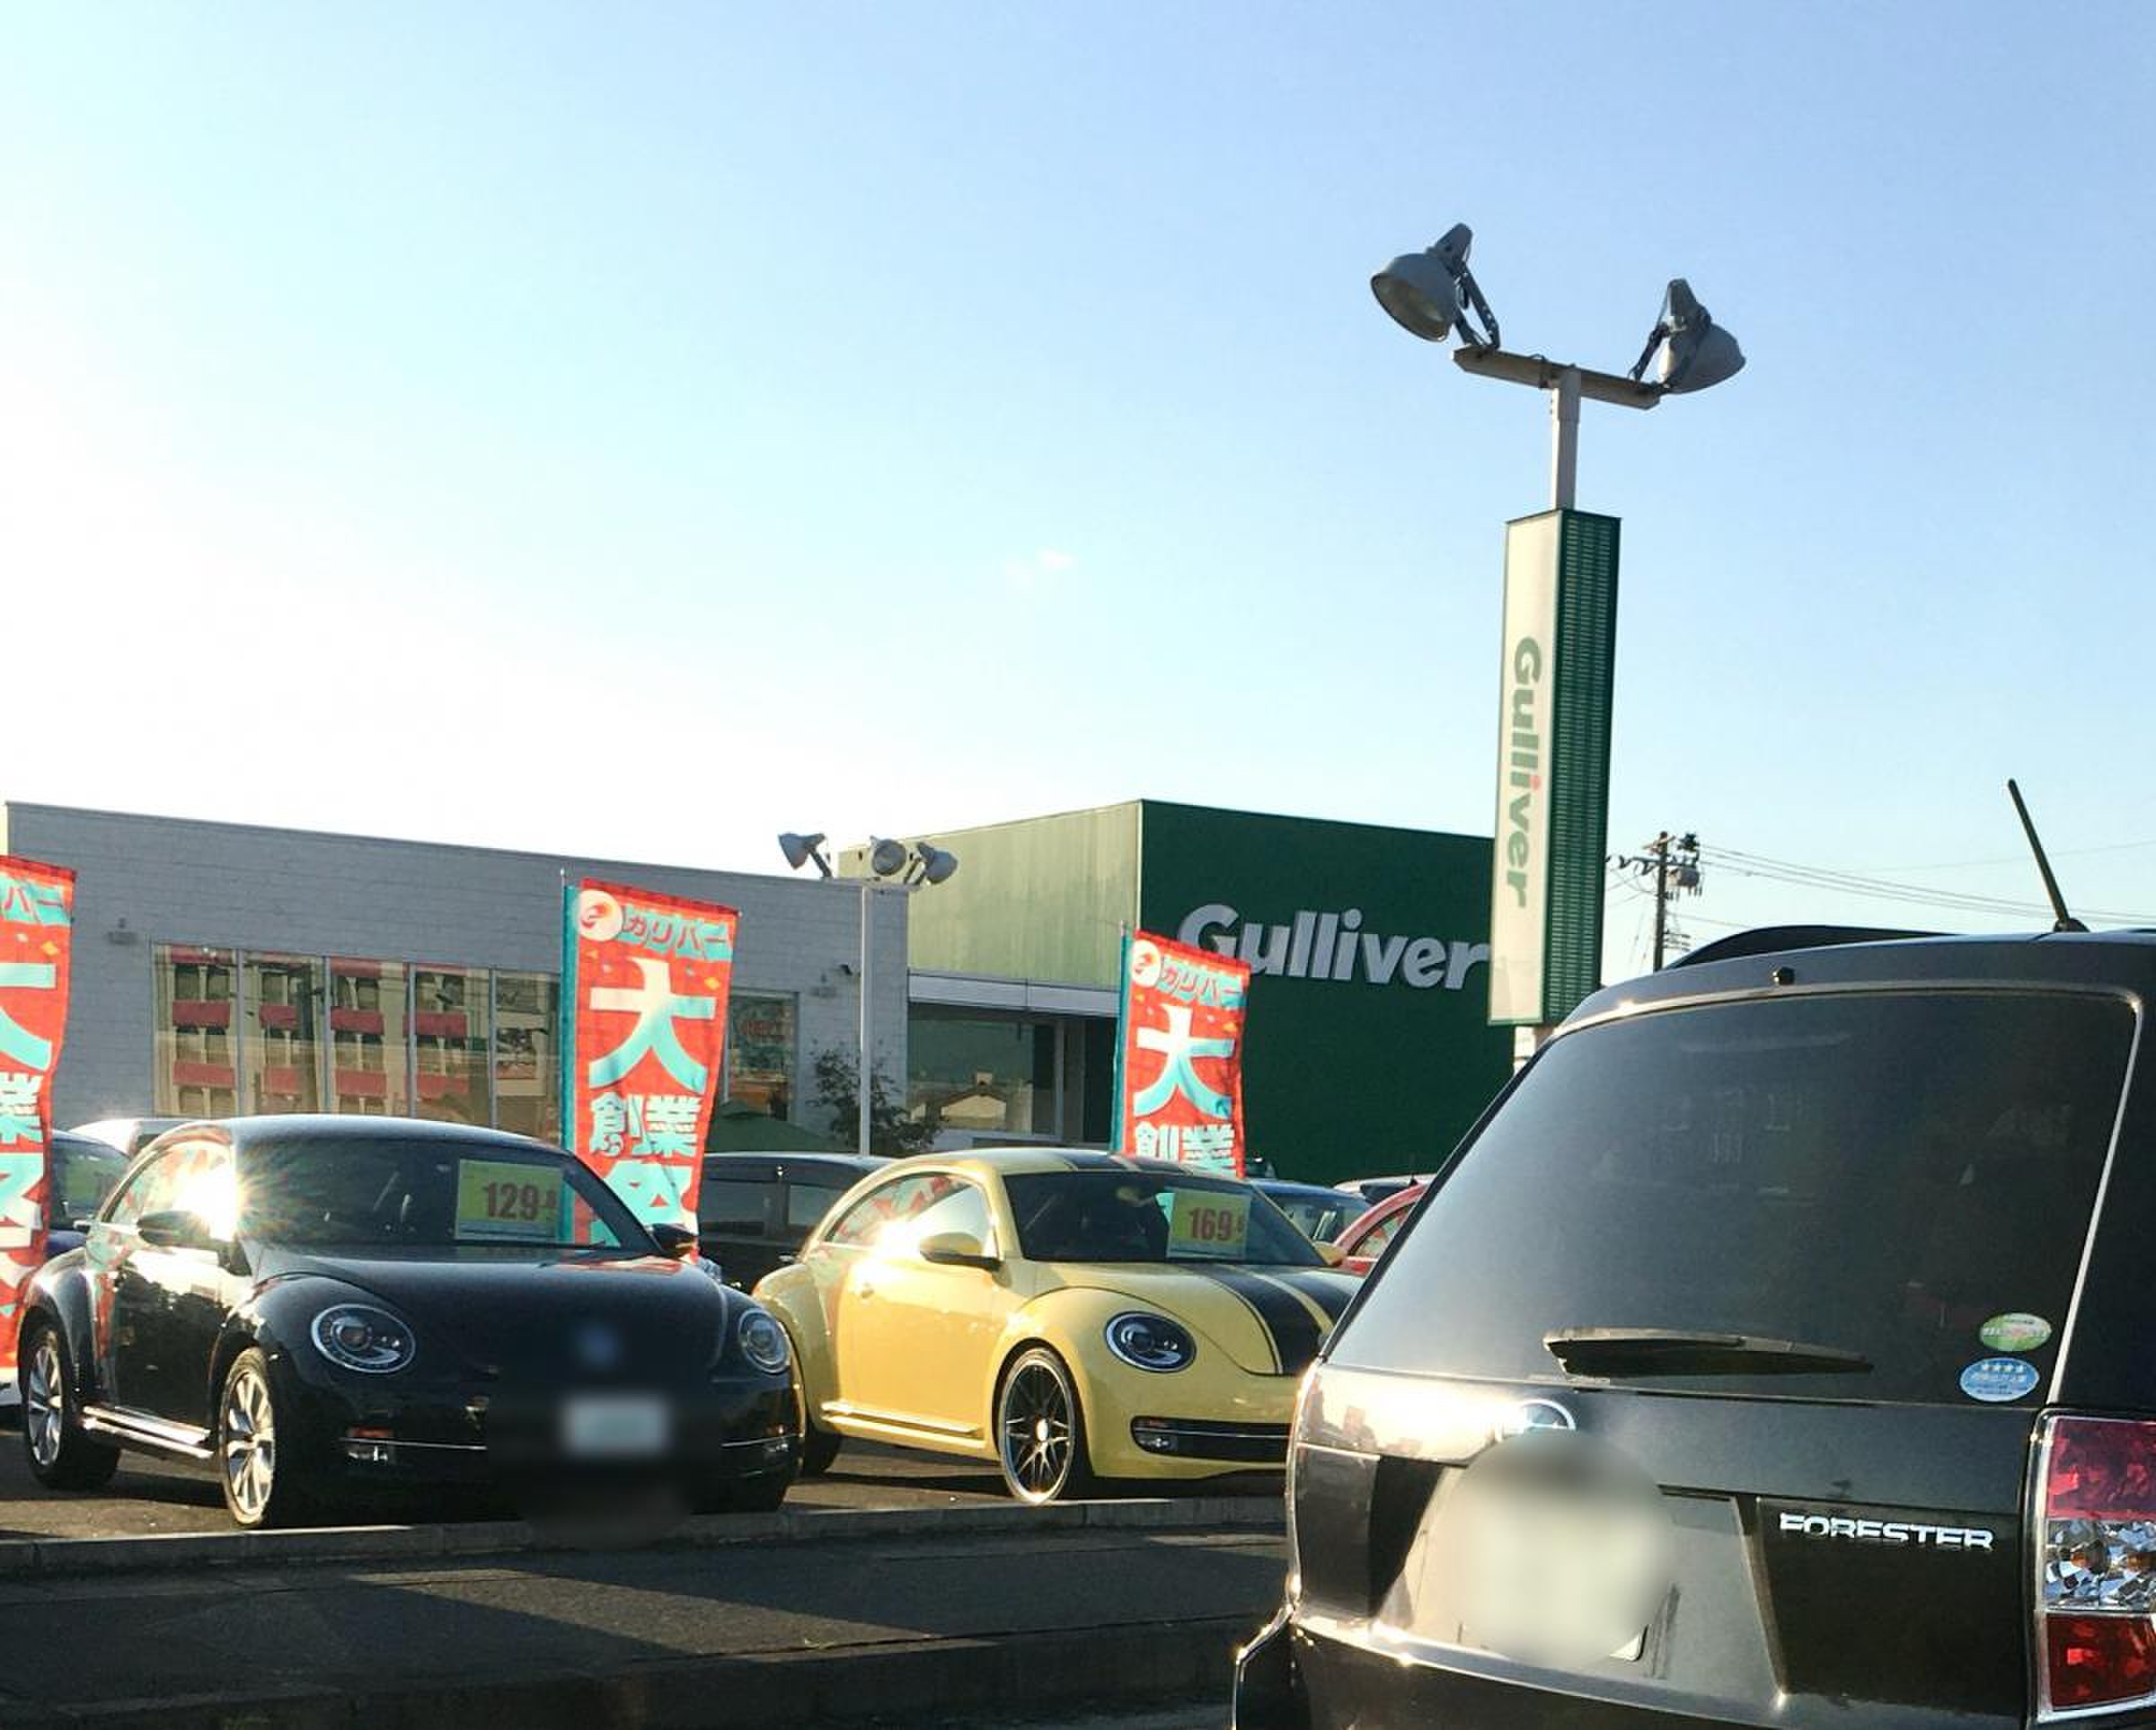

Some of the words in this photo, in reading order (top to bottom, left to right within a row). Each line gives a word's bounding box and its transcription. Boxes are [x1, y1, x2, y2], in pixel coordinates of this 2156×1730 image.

[1507, 636, 1542, 909] Gulliver
[1178, 903, 1490, 990] Gulliver
[589, 957, 717, 1093] 大
[1133, 1002, 1236, 1120] 大
[1779, 1512, 1994, 1551] FORESTER
